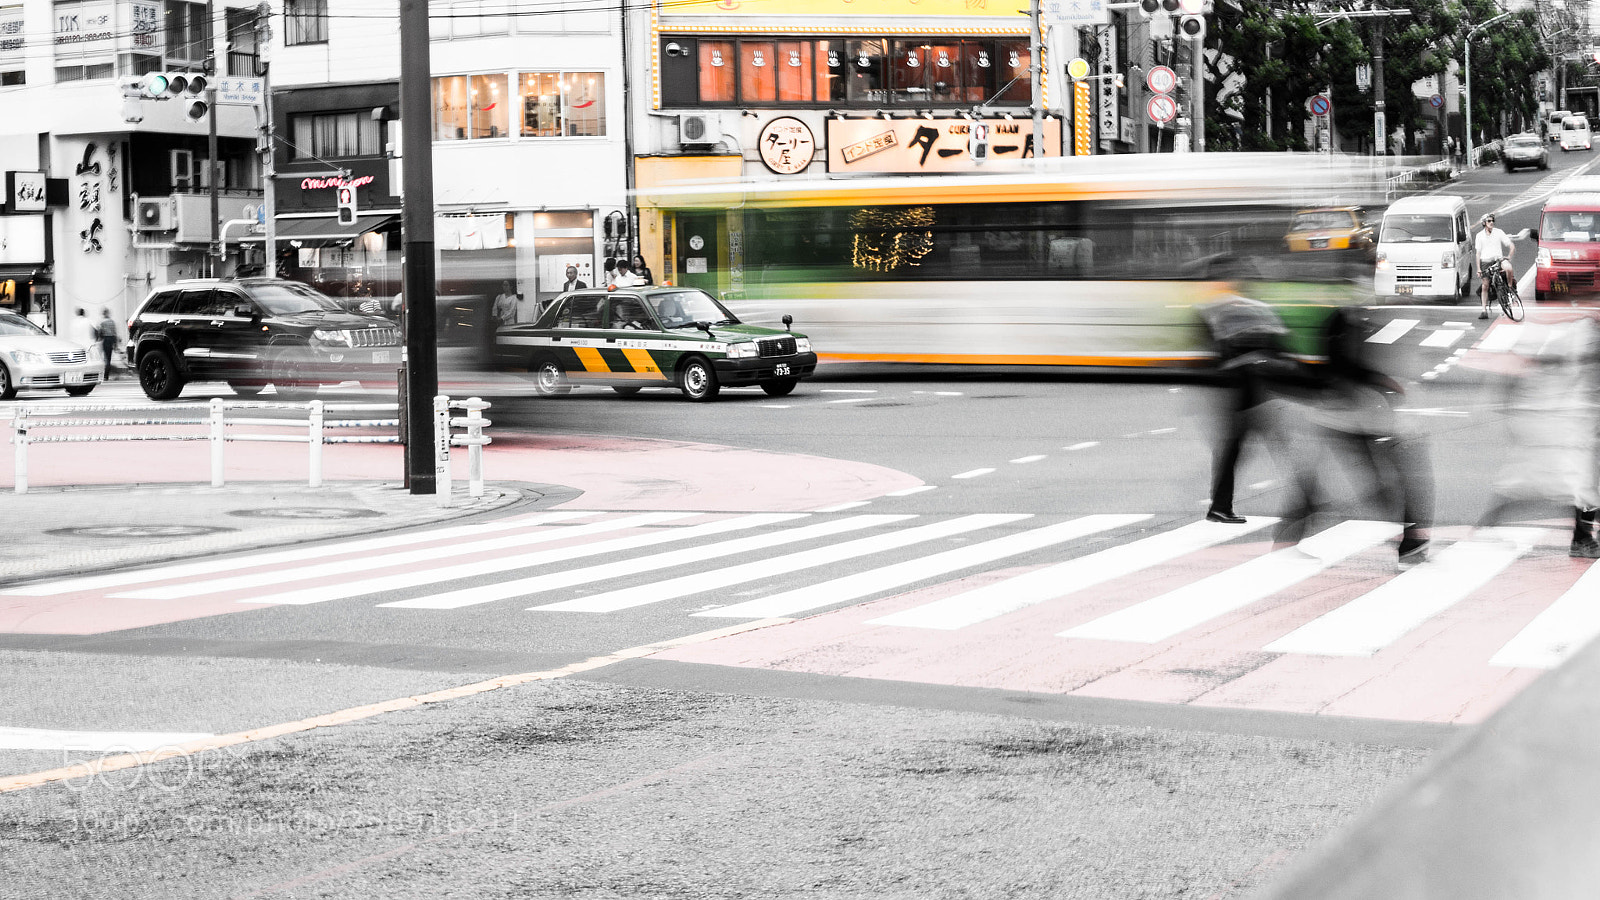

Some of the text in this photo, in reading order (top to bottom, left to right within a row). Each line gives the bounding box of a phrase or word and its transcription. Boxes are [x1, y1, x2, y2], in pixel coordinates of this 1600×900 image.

[59, 15, 79, 32] TSK
[220, 81, 261, 93] 並木橋
[766, 133, 809, 150] ターリー
[779, 149, 790, 164] 屋
